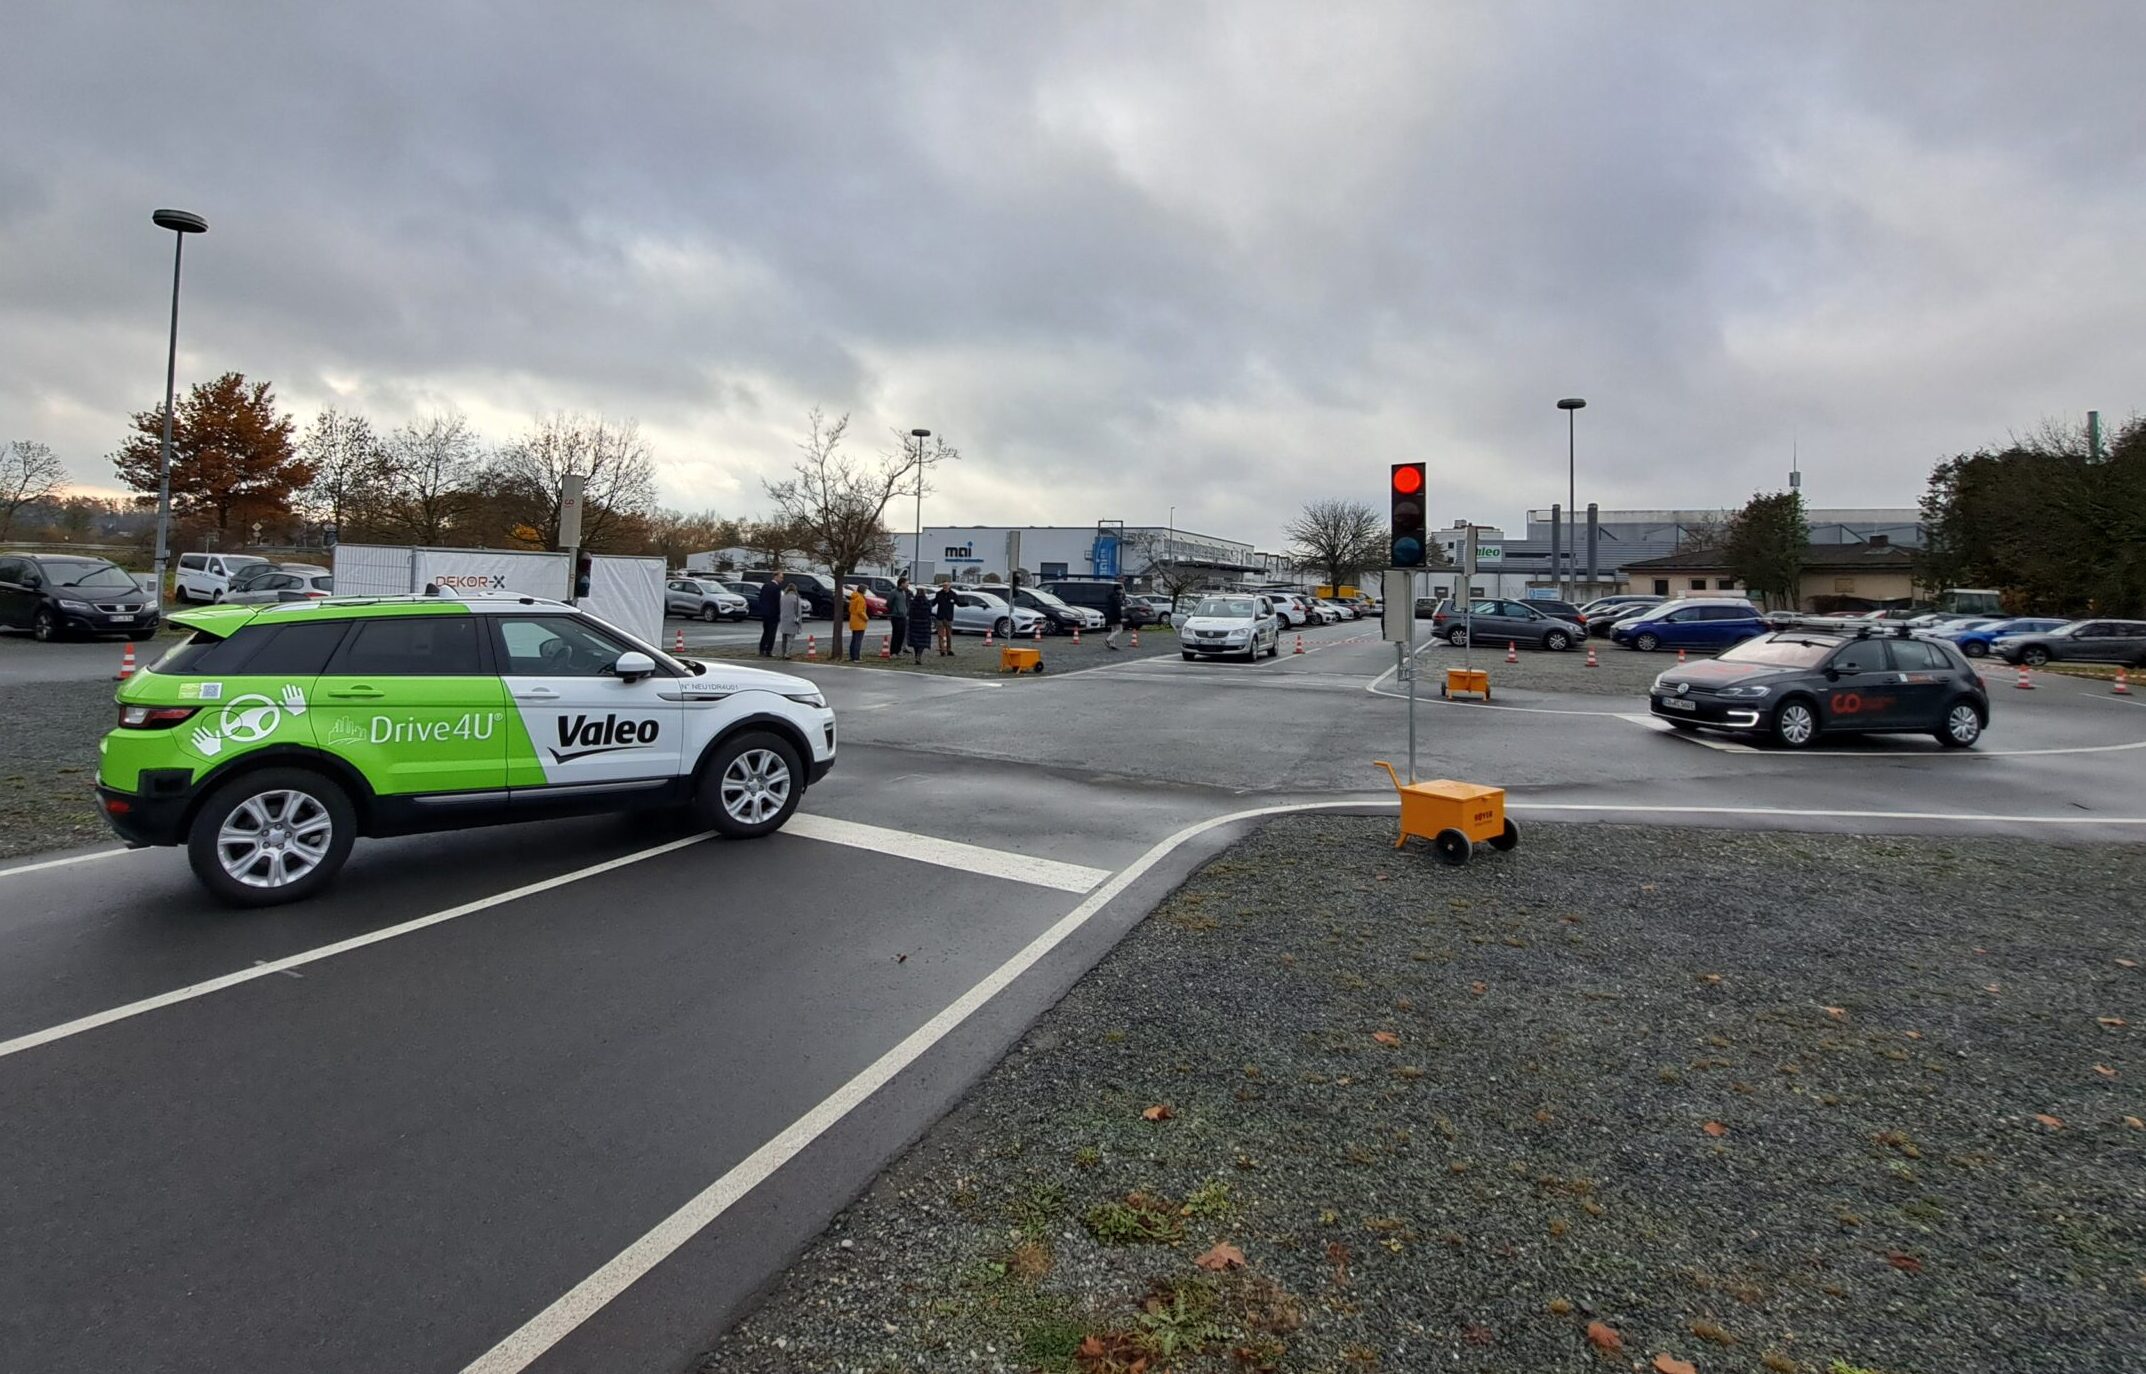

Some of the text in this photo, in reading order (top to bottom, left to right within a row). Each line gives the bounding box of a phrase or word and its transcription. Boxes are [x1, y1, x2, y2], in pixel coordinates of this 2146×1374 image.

[945, 541, 973, 557] mai
[435, 575, 505, 589] DEKOR-X
[557, 713, 660, 748] Valeo
